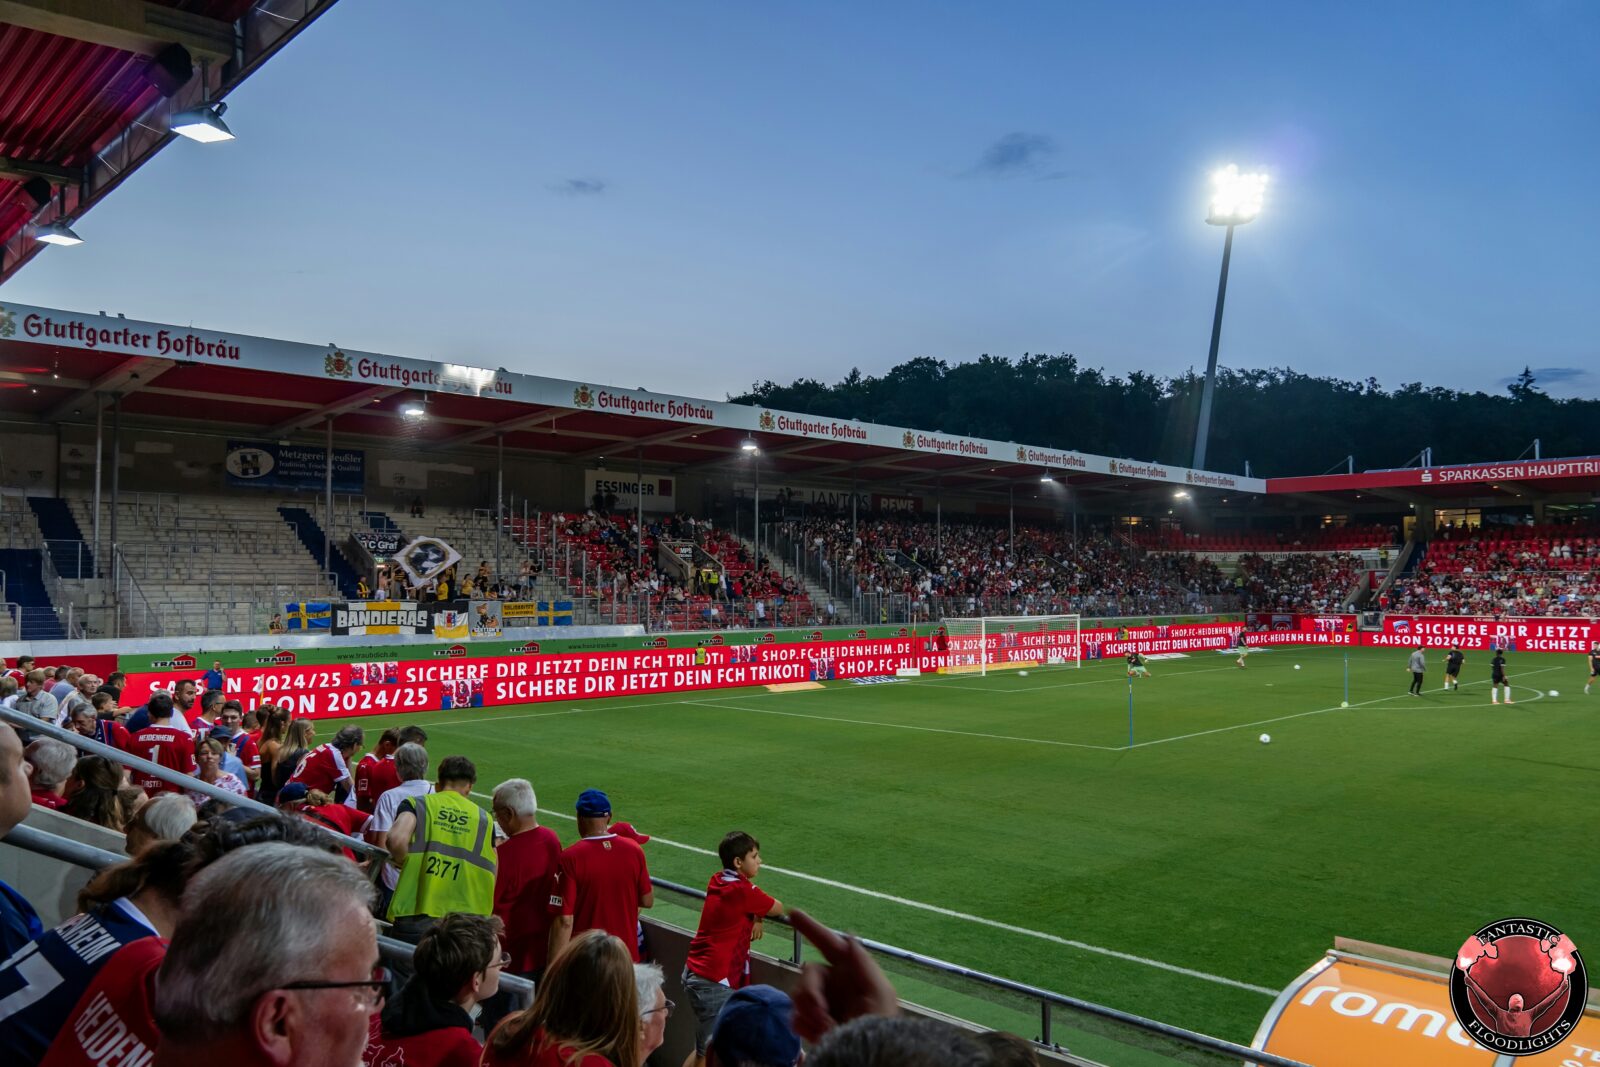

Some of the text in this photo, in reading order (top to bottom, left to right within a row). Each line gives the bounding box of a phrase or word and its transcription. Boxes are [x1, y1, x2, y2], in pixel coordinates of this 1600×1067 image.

[23, 313, 241, 361] Stuttgarter Hofbräu
[357, 358, 451, 387] Stuttgarte
[598, 391, 713, 419] Stuttgarter Hofbräu
[777, 415, 867, 440] Stuttgarter Hofbräu
[917, 437, 988, 456] Stuttgarter Hofbräu
[1439, 467, 1524, 482] SPARKASSEN
[596, 480, 655, 496] ESSINGER
[880, 497, 914, 512] REWE
[337, 610, 428, 628] BANDIERAS
[1074, 633, 1094, 643] JTZT
[1095, 632, 1113, 642] DEIN
[1129, 630, 1155, 640] TRIKOT!
[1246, 633, 1350, 644] HOP.FC-HEIDENHEIM.DE
[1415, 624, 1591, 638] SICHERE DIR JETZT
[1105, 636, 1226, 655] SICHERE DIR JETZT DEIN FCH TRIKOT!
[1373, 635, 1482, 647] SAISON 2024/25
[1526, 639, 1586, 651] SICHERE
[255, 656, 292, 664] TRAUB
[762, 643, 911, 662] SHOP.FC-HEIDENHEIM.DE
[1008, 649, 1043, 662] SAISON
[151, 660, 193, 668] TRAUB
[405, 664, 489, 683] SICHERE
[496, 662, 527, 678] DIR
[533, 660, 582, 676] JETZT
[588, 657, 627, 672] DEIN
[633, 655, 663, 669] FCH
[252, 672, 342, 692] 2024/25
[496, 664, 804, 700] SICHERE DIR JETZT DEIN FCH TRIKOT!
[327, 688, 428, 712] 2024/25
[138, 734, 175, 743] HEIDENHEIM
[437, 810, 469, 826] SDS
